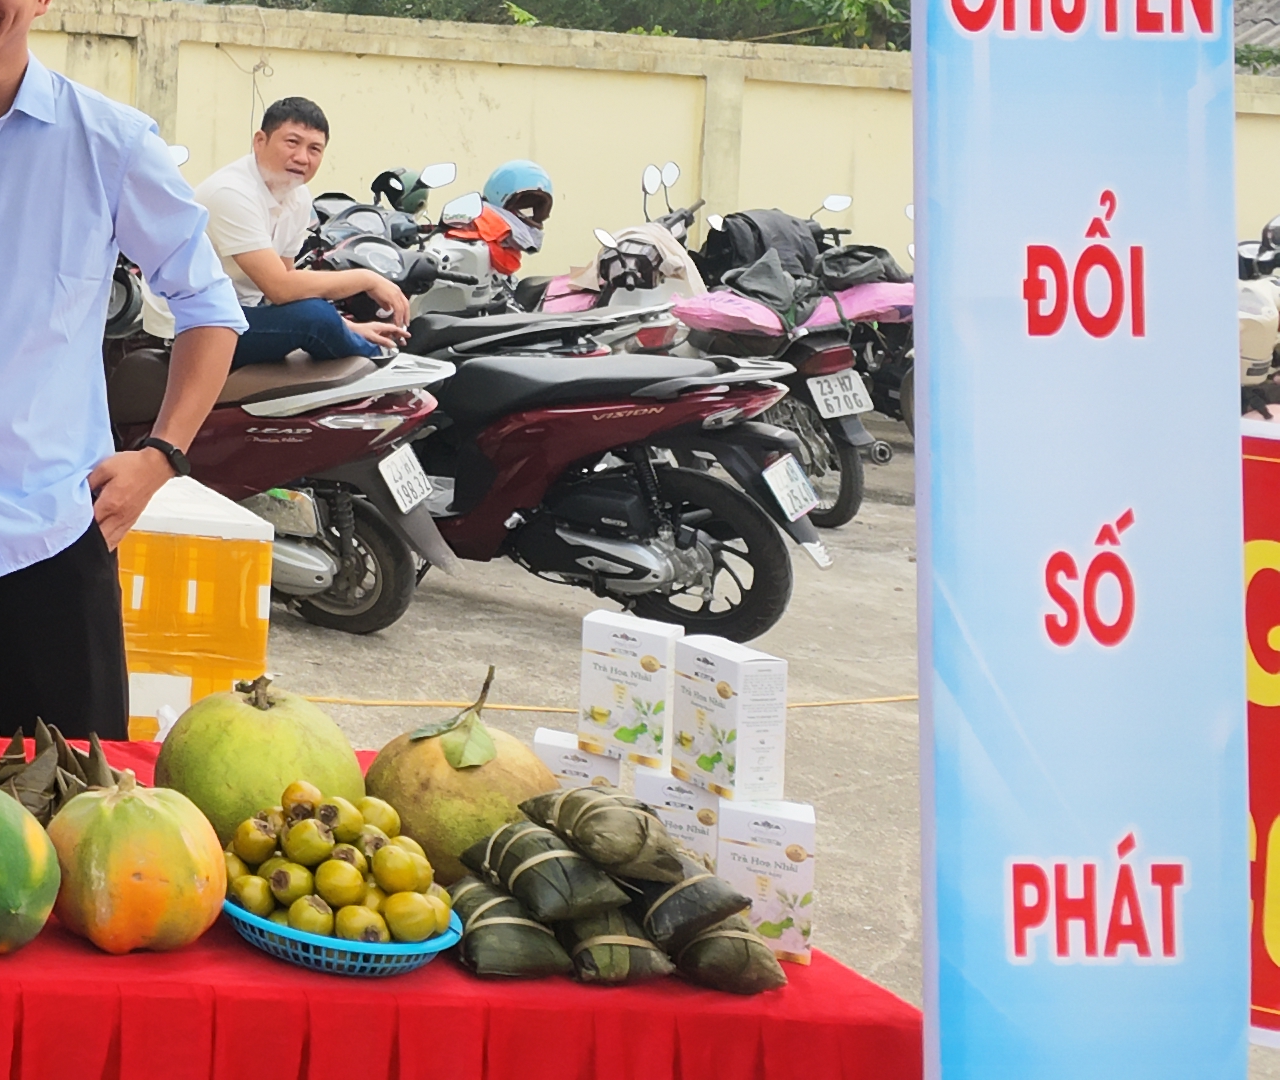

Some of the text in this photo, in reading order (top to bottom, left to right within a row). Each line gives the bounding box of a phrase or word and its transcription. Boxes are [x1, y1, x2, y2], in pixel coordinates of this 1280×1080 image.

[1022, 190, 1146, 338] ĐỔI
[245, 427, 313, 435] LEAD
[591, 406, 666, 422] VISION
[1045, 507, 1136, 647] SỐ
[1011, 833, 1185, 957] PHÁT
